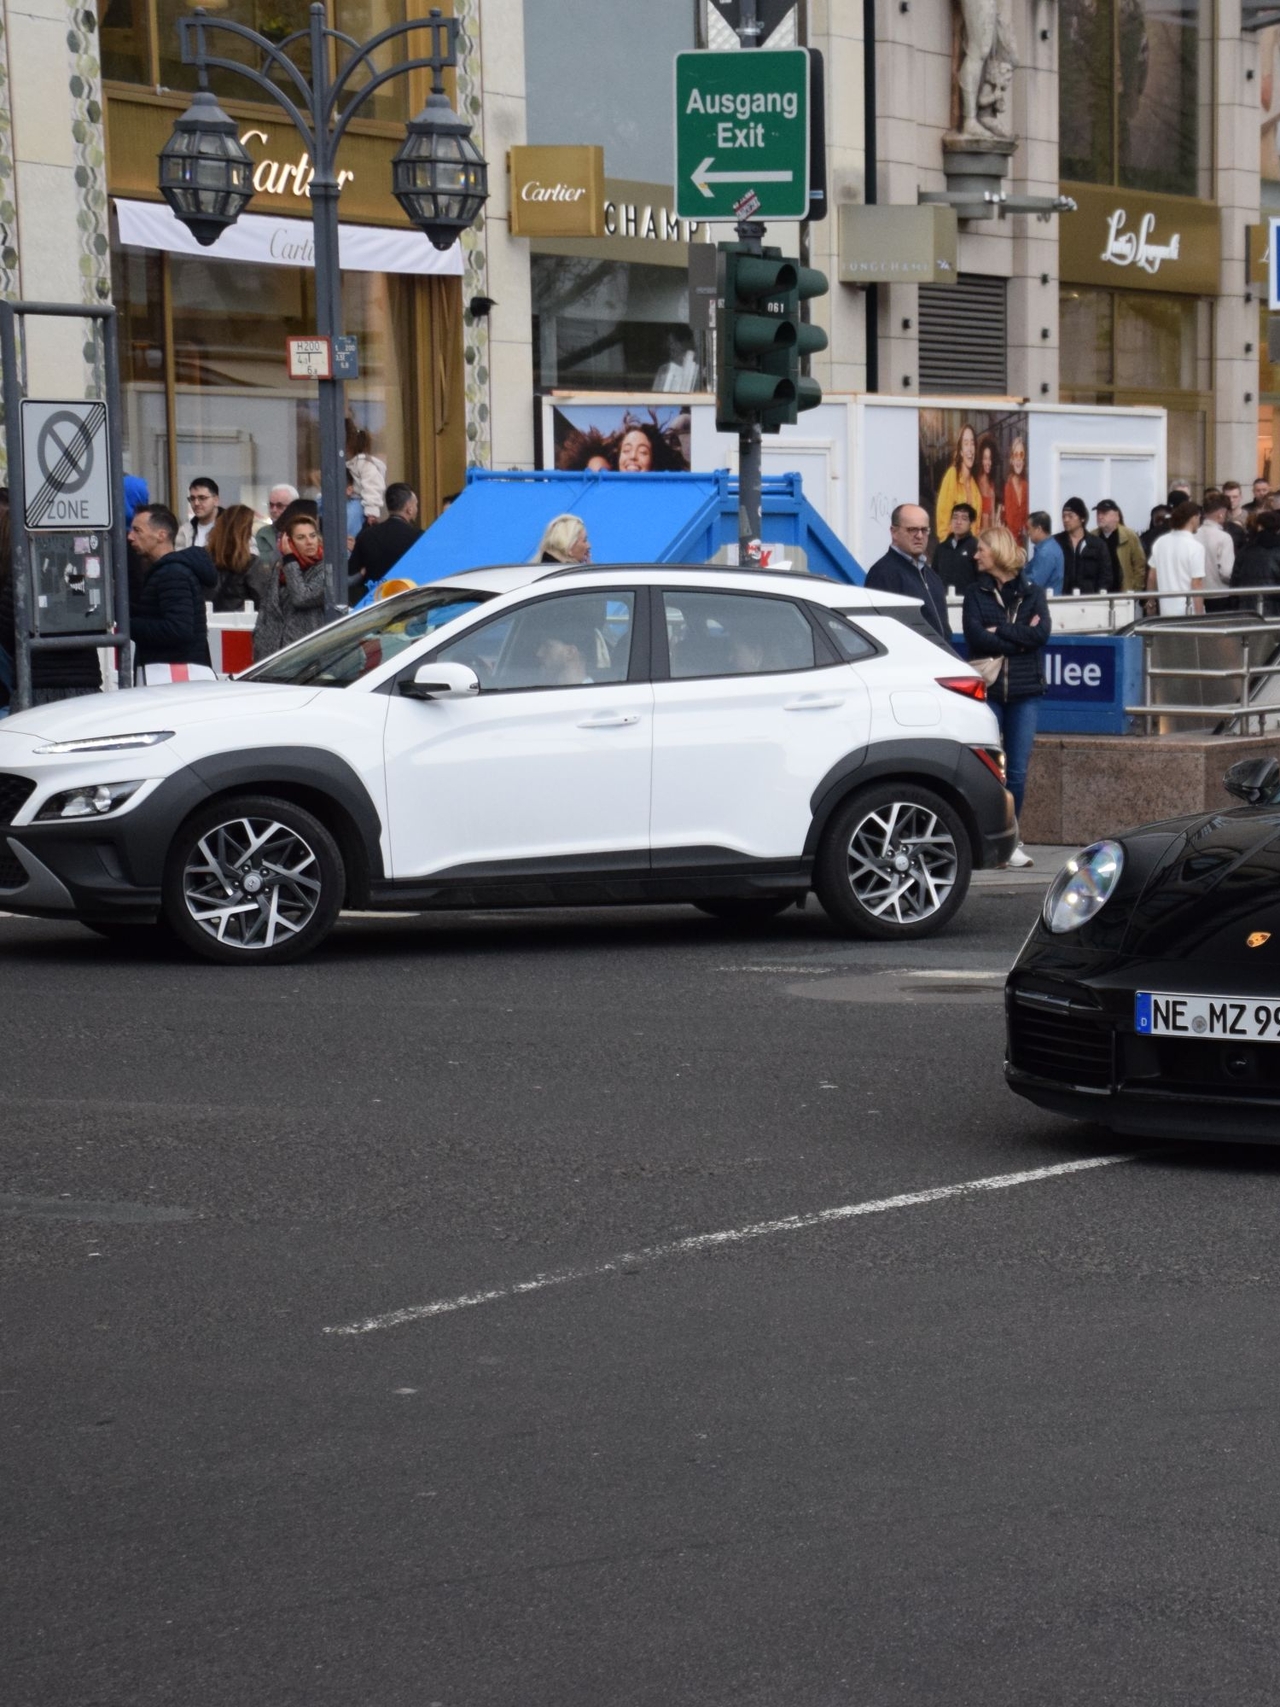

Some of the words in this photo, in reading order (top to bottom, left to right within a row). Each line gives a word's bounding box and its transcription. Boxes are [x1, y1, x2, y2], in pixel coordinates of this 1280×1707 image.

[686, 88, 798, 120] Ausgang
[717, 121, 765, 148] Exit
[232, 130, 354, 198] Cartir
[521, 181, 586, 202] Cartier
[270, 228, 316, 262] Carti
[47, 500, 89, 519] ZONE
[1140, 1017, 1148, 1027] D
[1153, 999, 1189, 1031] NE
[1209, 1002, 1247, 1035] MZ
